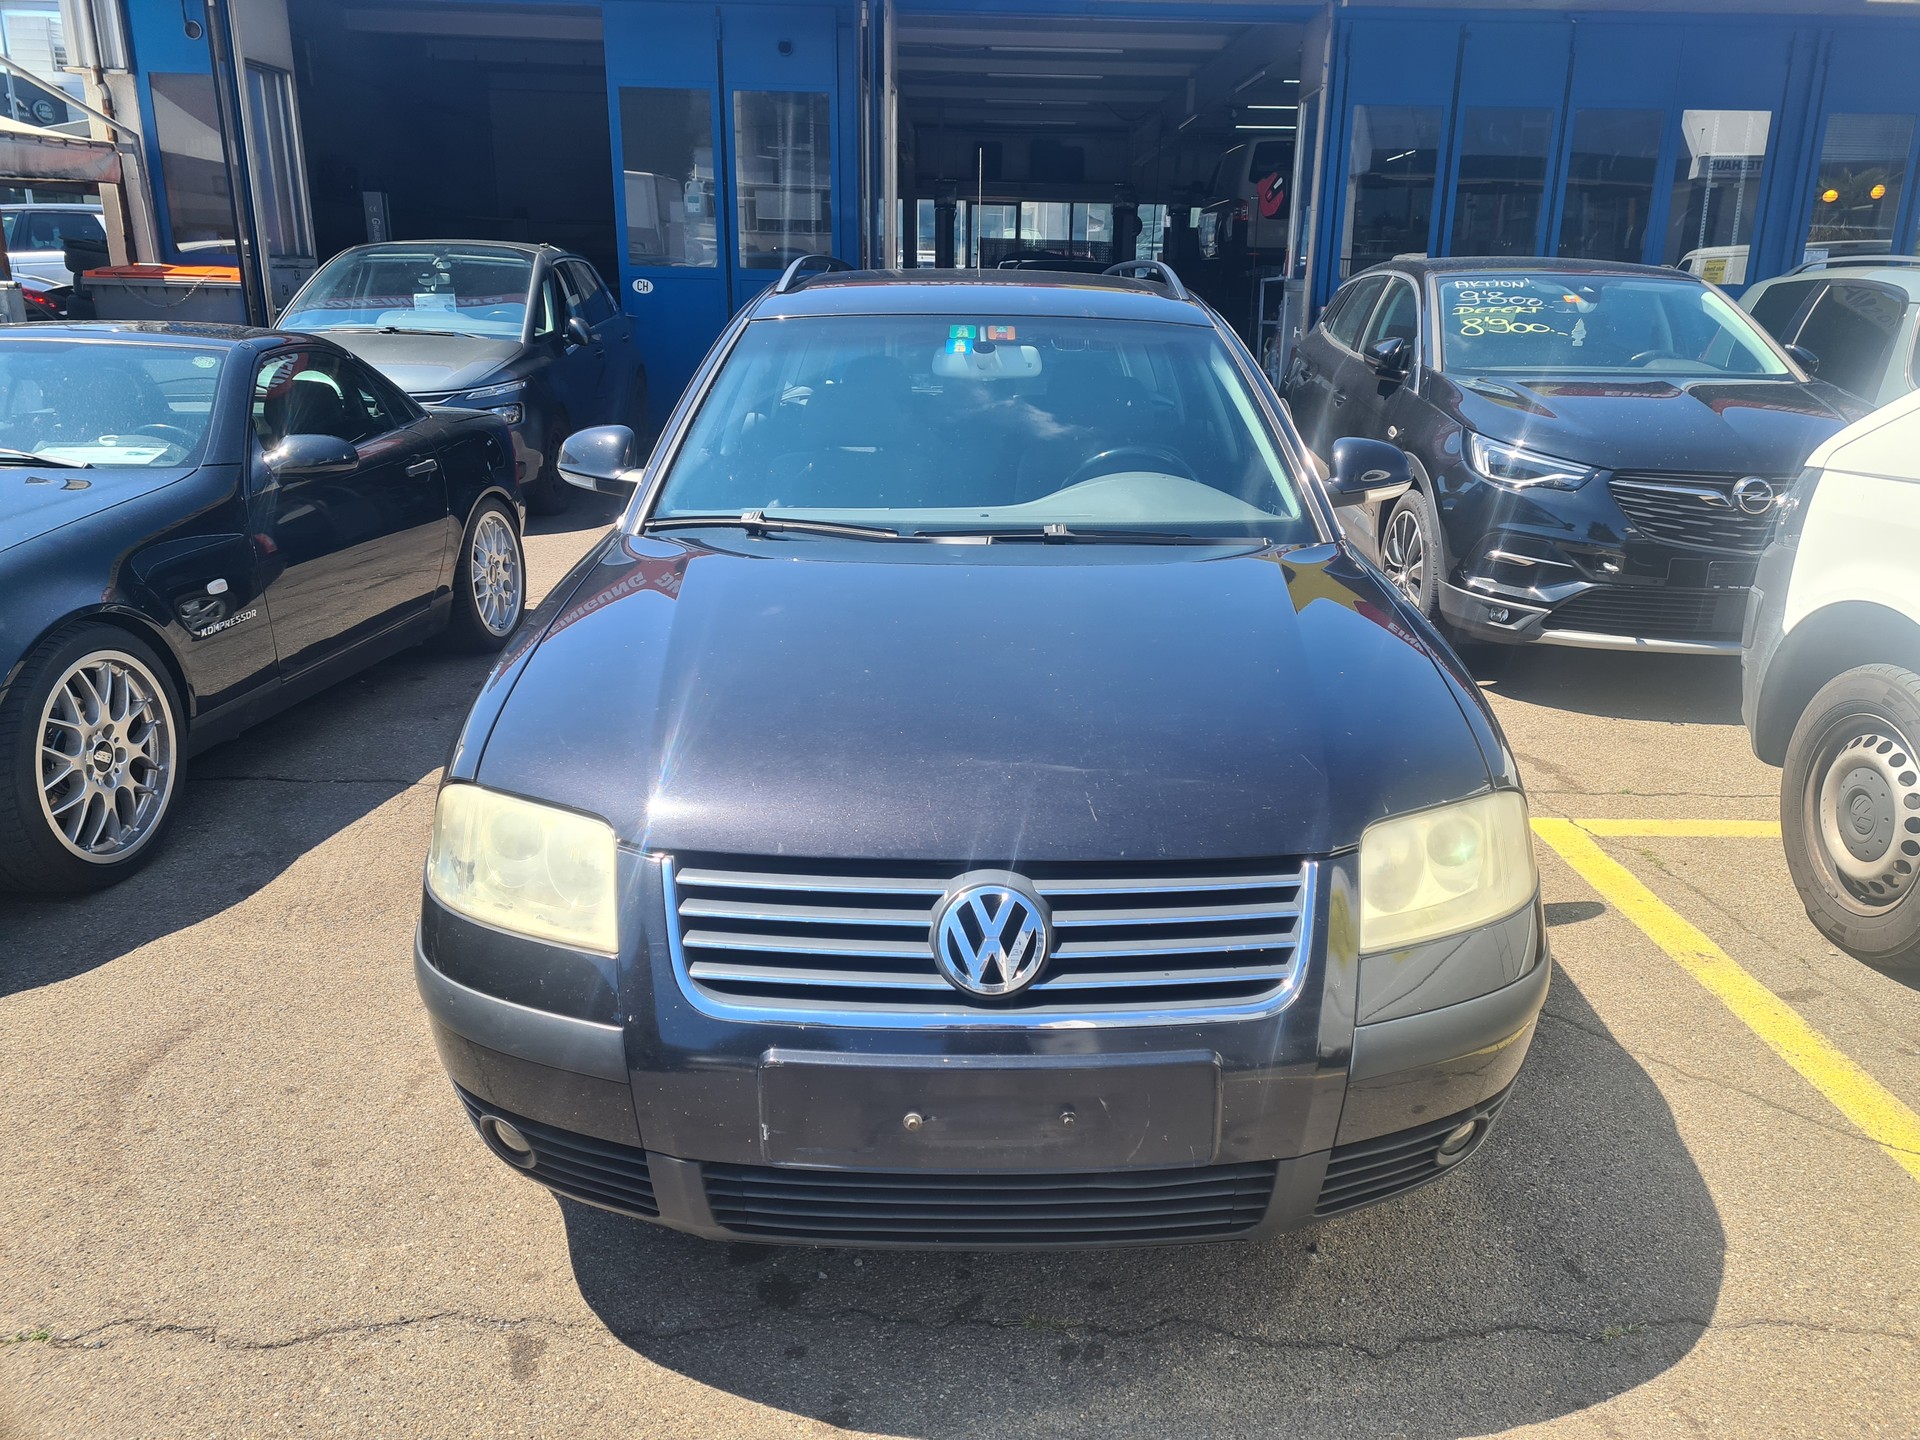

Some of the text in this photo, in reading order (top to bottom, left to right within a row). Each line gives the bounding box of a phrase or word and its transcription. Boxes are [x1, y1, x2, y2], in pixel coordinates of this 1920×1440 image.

[637, 280, 649, 292] CH
[200, 608, 257, 638] KOMPRESSOR
[939, 885, 1046, 996] VW
